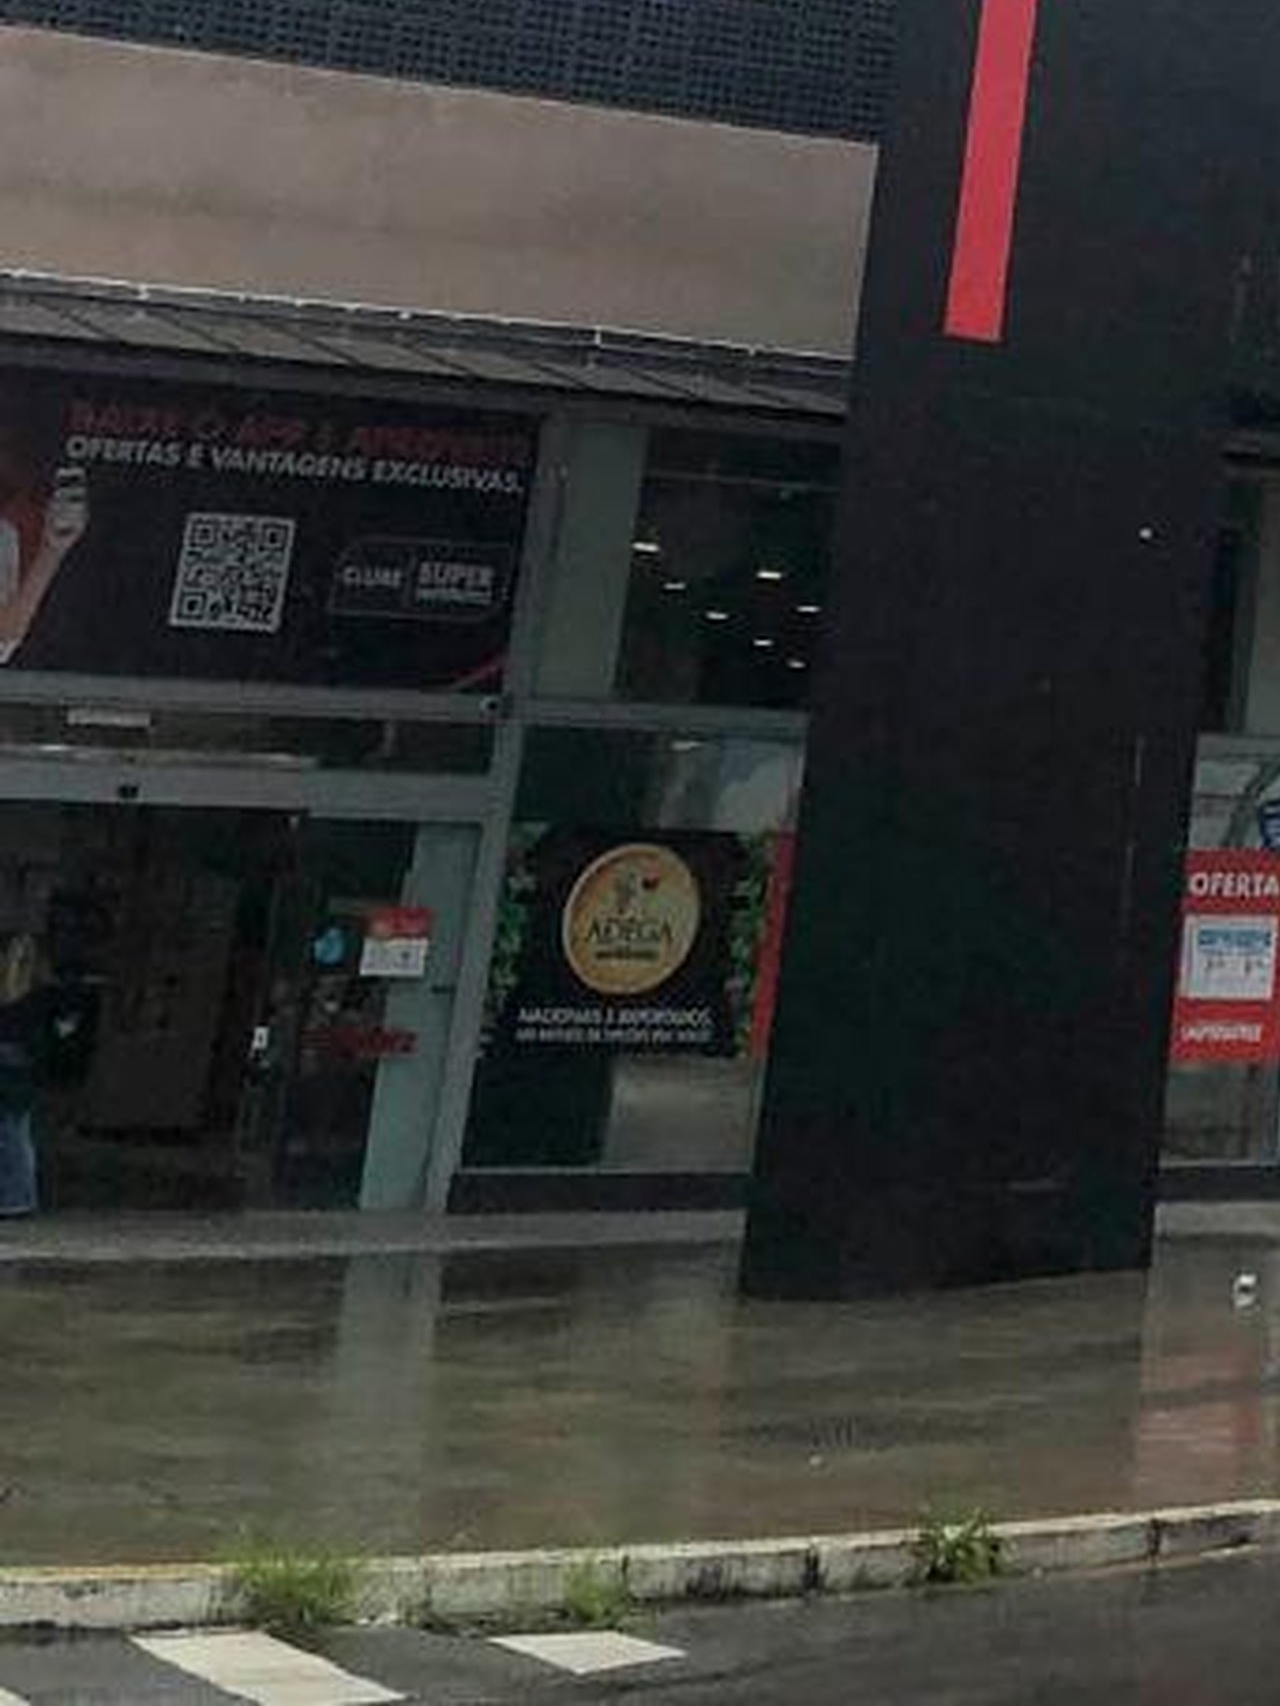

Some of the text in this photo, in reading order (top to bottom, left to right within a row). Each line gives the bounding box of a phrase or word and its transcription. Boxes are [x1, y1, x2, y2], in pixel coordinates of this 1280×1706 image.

[64, 434, 182, 467] OFERTAS
[186, 443, 207, 469] E
[211, 444, 367, 482] VANTAGENS
[1188, 871, 1280, 897] OFERTA
[585, 918, 673, 943] ADEGA
